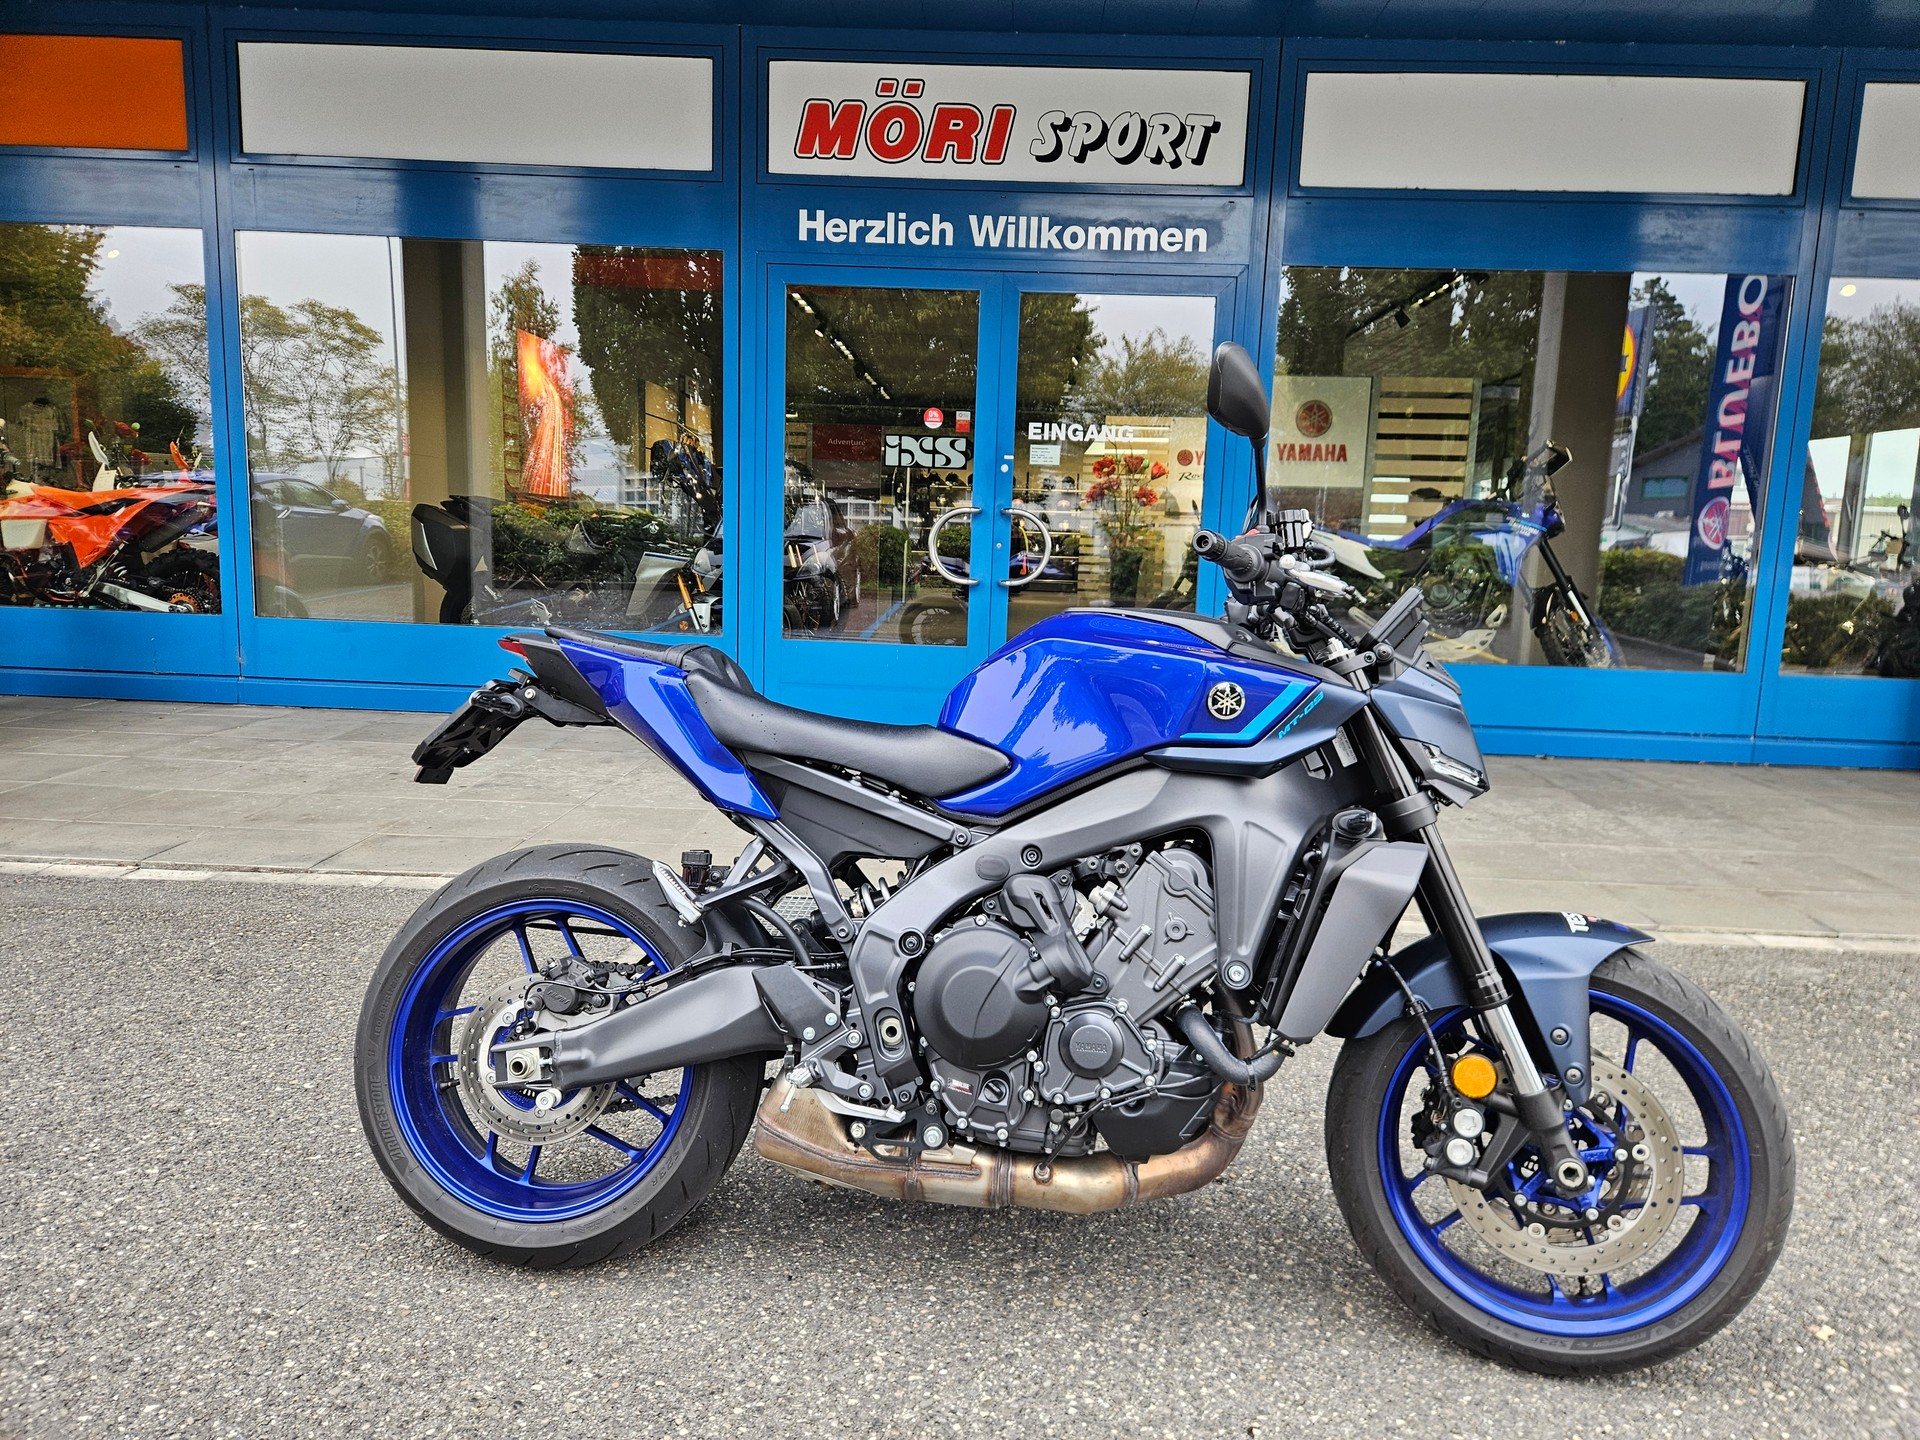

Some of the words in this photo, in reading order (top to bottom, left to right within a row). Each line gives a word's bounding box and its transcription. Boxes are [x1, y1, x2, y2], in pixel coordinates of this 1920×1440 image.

[794, 78, 1017, 164] MÖRI
[1030, 110, 1222, 169] SPORT
[798, 209, 954, 246] Herzlich
[968, 214, 1208, 252] Willkommen
[827, 438, 866, 446] Adventure
[1028, 422, 1134, 442] EINGANG
[1276, 443, 1348, 462] YAMAHA
[1277, 691, 1324, 740] MT-09
[1075, 1041, 1107, 1054] YAMAHA
[369, 1074, 405, 1162] BRIDGESTONE
